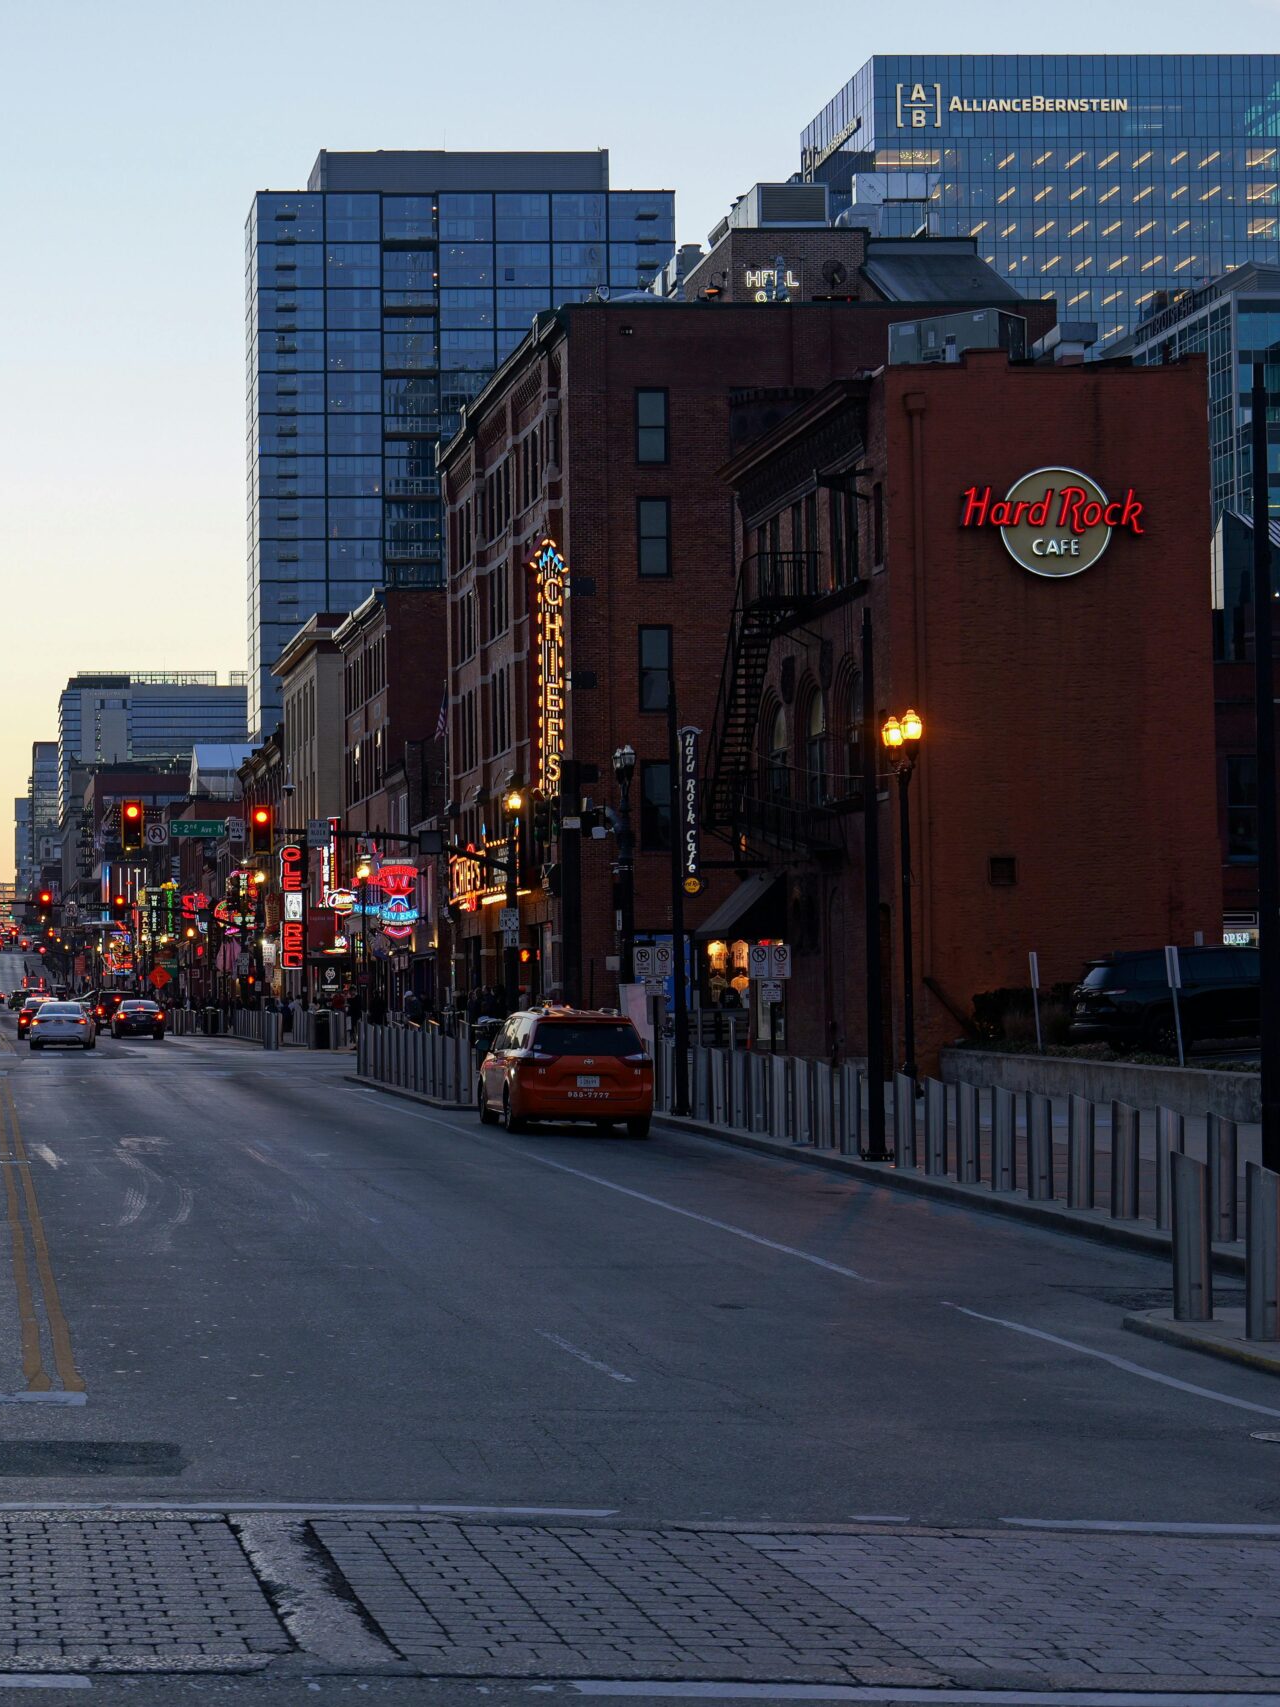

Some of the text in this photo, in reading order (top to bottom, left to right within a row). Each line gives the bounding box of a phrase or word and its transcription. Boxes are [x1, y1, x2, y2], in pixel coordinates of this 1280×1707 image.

[963, 486, 1145, 535] Hard Rock
[1032, 538, 1080, 556] CAFE
[543, 577, 562, 782] CHIEFS
[685, 733, 697, 873] Hard Rock Cafe
[282, 848, 302, 891] OLE
[283, 923, 302, 967] RED
[1223, 932, 1250, 945] OPEN
